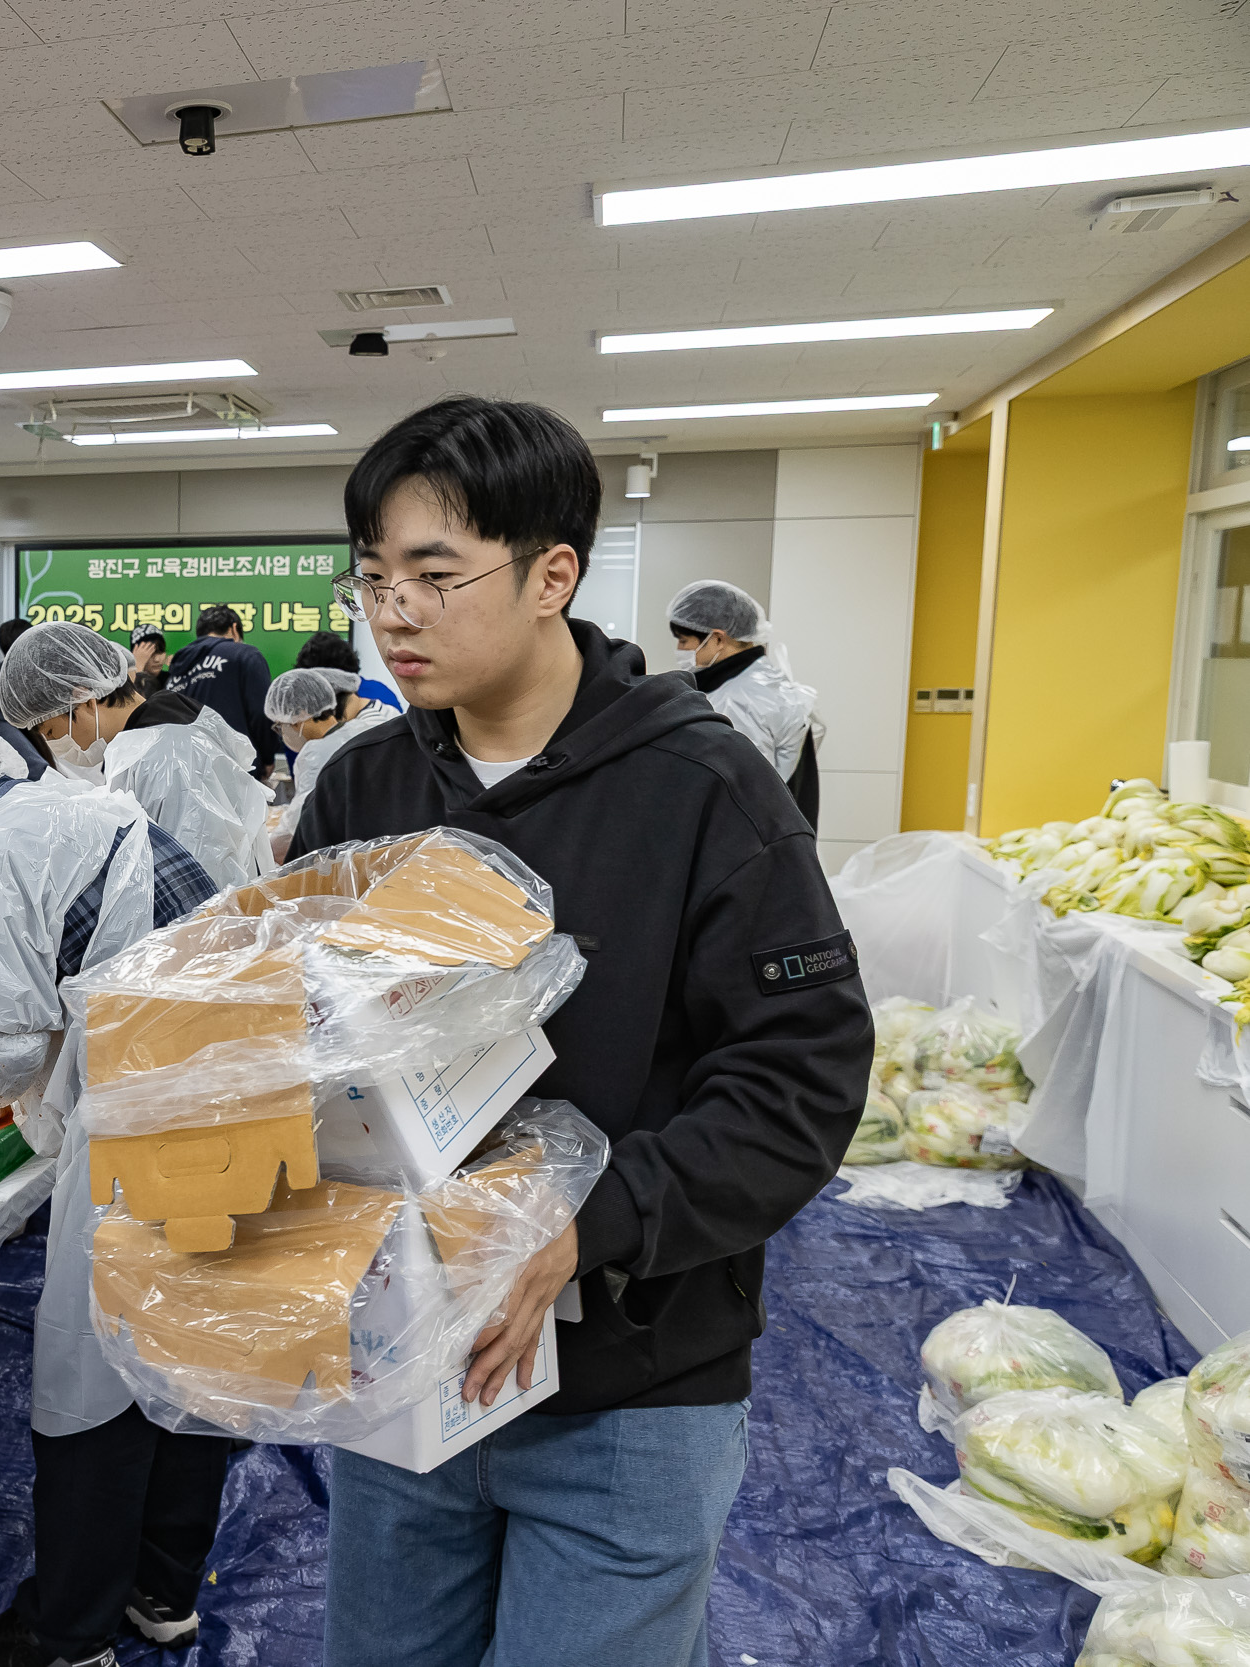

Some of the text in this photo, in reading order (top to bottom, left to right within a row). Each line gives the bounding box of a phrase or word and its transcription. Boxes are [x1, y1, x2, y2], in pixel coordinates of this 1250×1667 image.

[87, 554, 334, 579] 광진구 교육경비보조사업 선정
[27, 604, 105, 632] 2025
[109, 603, 192, 632] 사랑의
[263, 602, 321, 632] 나눔
[804, 947, 843, 964] NATIONAL
